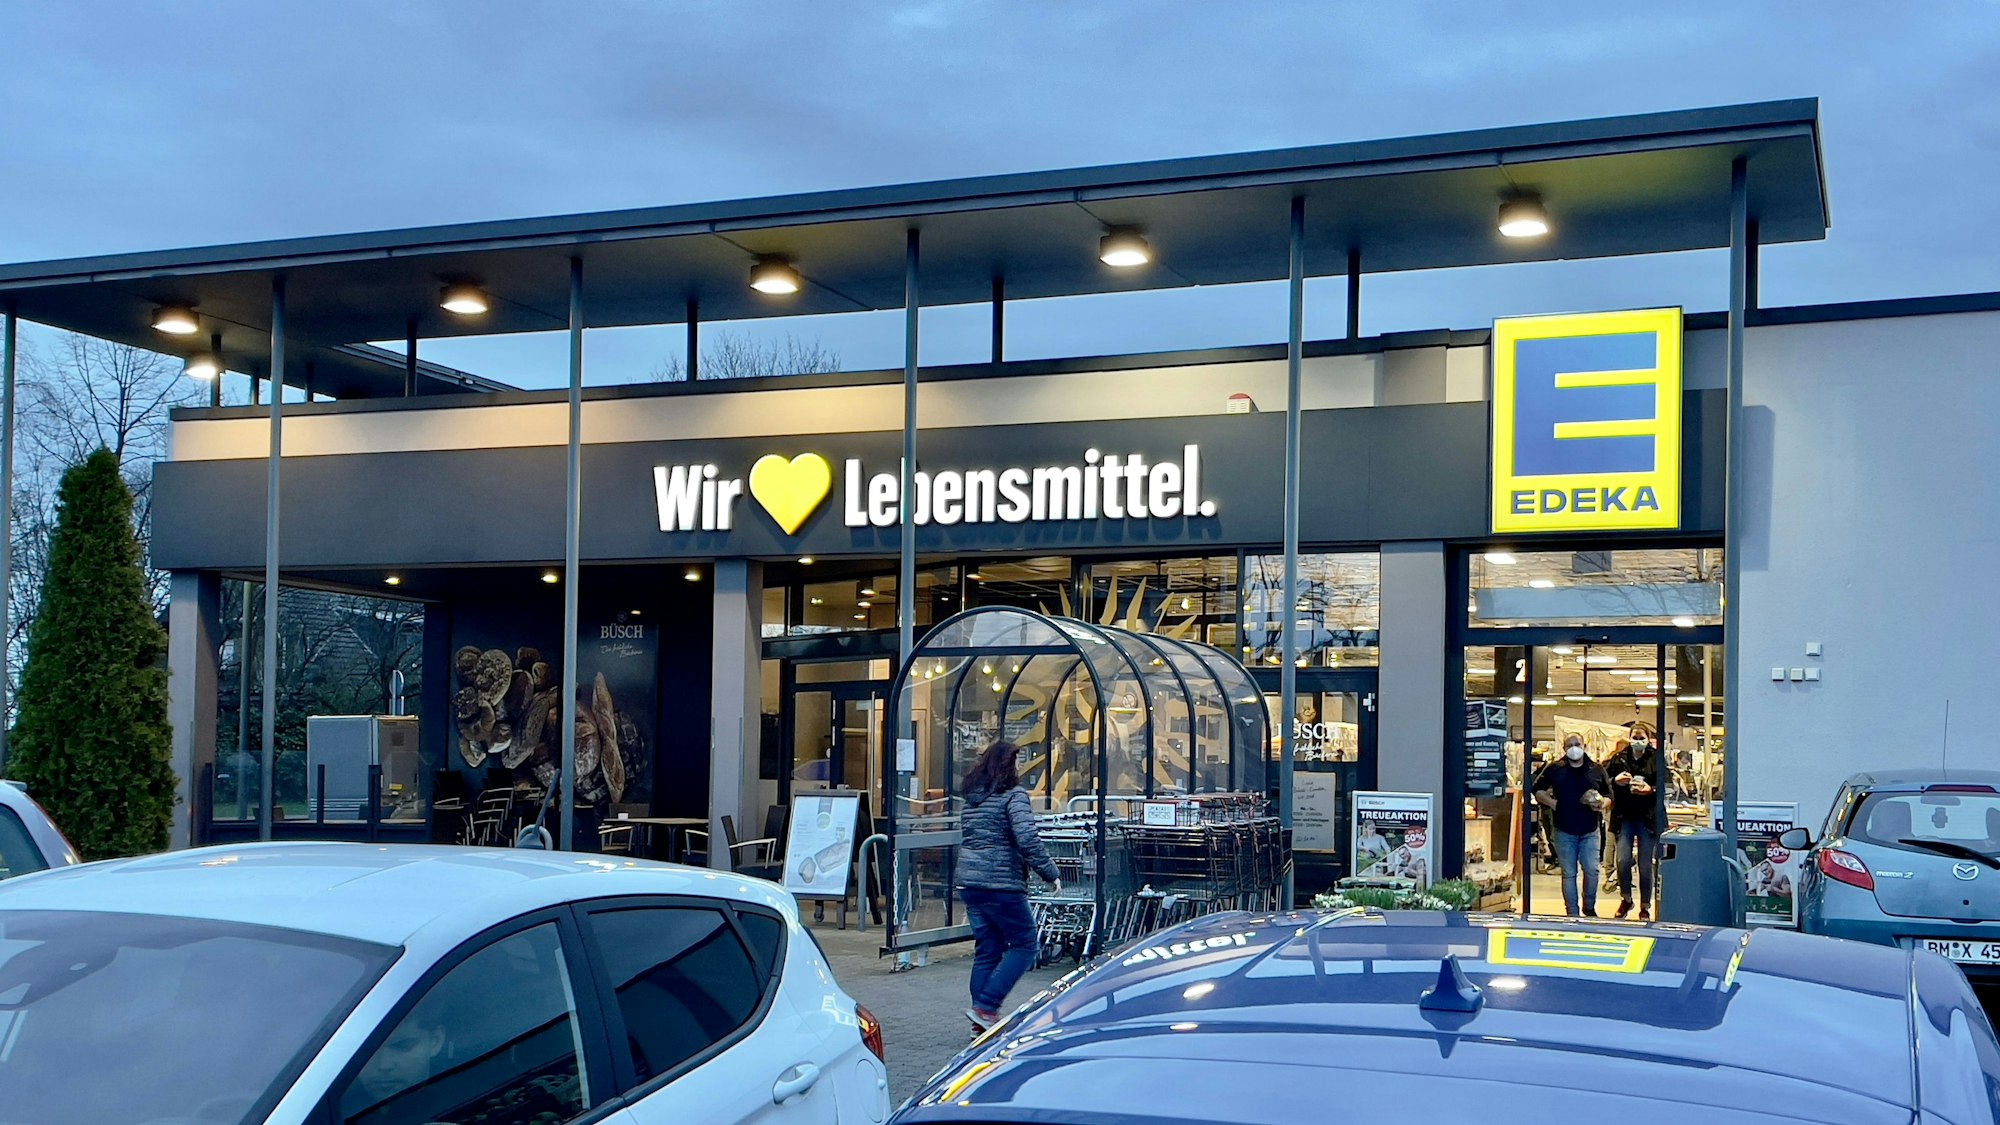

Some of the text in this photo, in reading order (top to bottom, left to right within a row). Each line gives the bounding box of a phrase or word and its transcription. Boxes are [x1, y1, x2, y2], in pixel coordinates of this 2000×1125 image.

[653, 444, 1217, 531] Wir Lebensmittel.
[1510, 486, 1659, 514] EDEKA
[600, 622, 644, 639] BÜSCH
[1360, 810, 1427, 821] TREUEAKTION
[1718, 821, 1791, 833] TUEAKTION
[1404, 833, 1426, 843] 50%
[1928, 941, 1950, 957] BM
[1962, 943, 1972, 958] X
